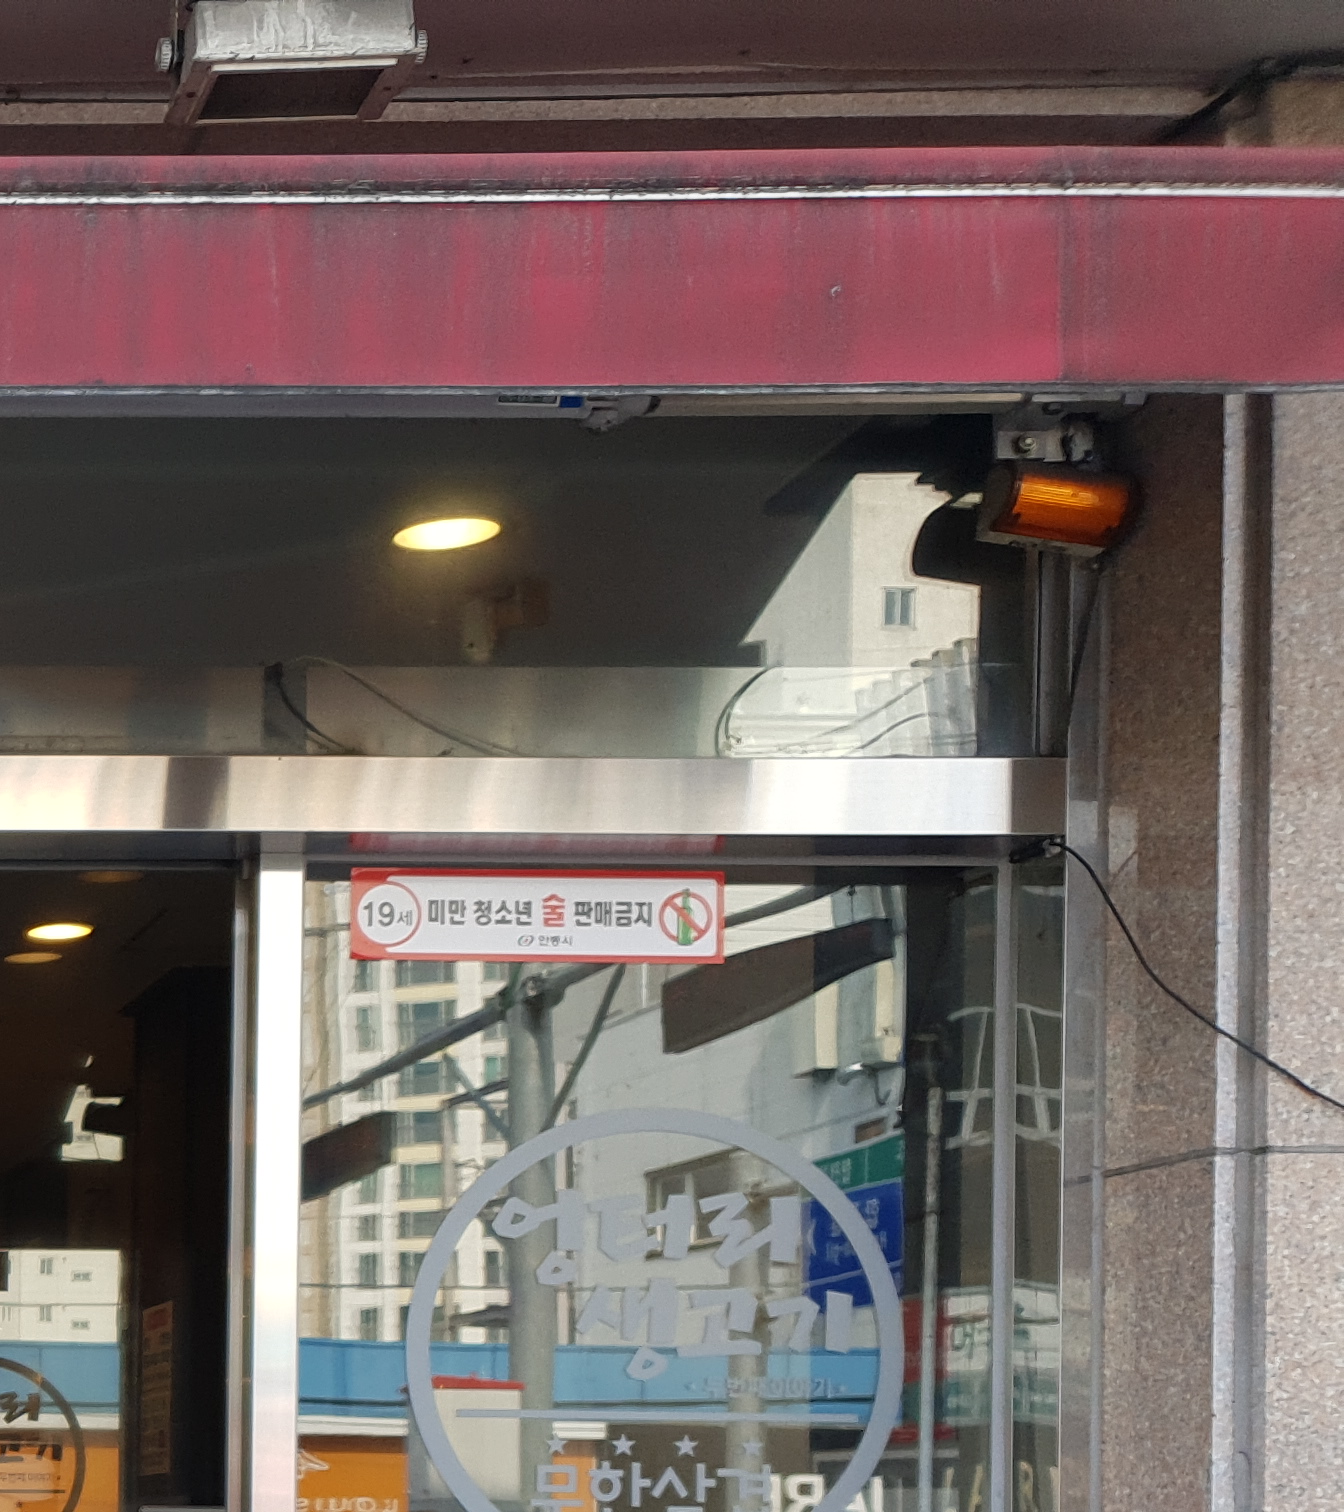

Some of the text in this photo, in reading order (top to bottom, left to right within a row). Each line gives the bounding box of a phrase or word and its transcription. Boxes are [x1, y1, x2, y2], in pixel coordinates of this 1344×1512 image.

[428, 899, 466, 927] 미만
[473, 899, 532, 927] 청소년
[542, 893, 566, 928] 술
[573, 900, 653, 928] 판매금지
[492, 1188, 801, 1286] 엉터리
[575, 1278, 853, 1380] 생고기
